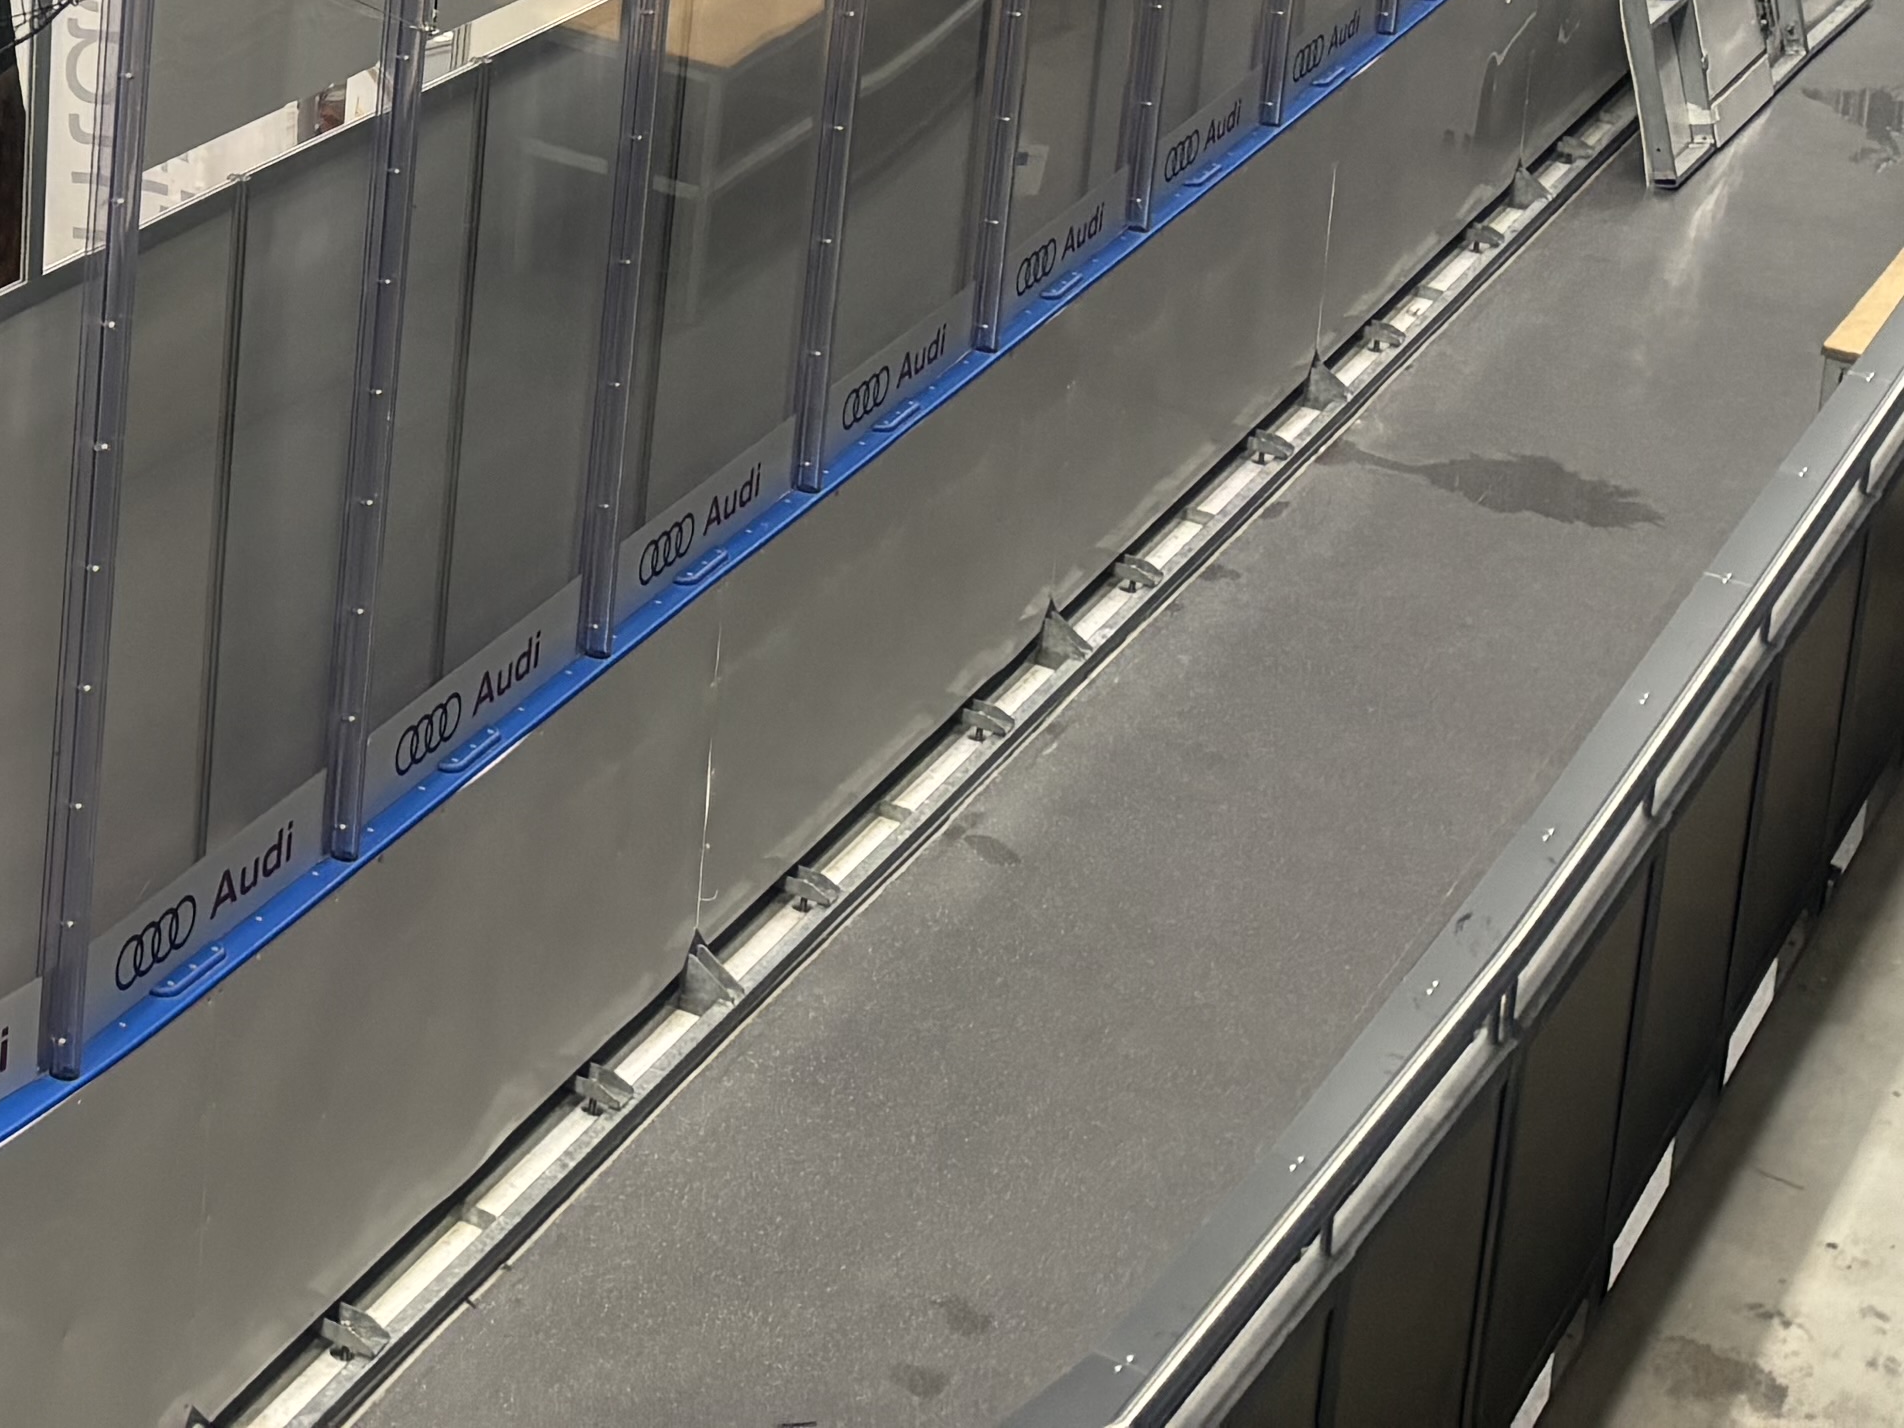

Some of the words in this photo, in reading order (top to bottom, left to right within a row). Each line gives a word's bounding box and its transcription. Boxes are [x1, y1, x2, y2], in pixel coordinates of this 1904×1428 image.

[1325, 8, 1362, 56] Audi
[1202, 100, 1243, 152] Audi
[1063, 200, 1106, 259] Audi
[895, 322, 948, 395] Audi
[702, 461, 763, 528] Audi
[472, 629, 543, 719] Audi
[209, 821, 294, 920] Audi
